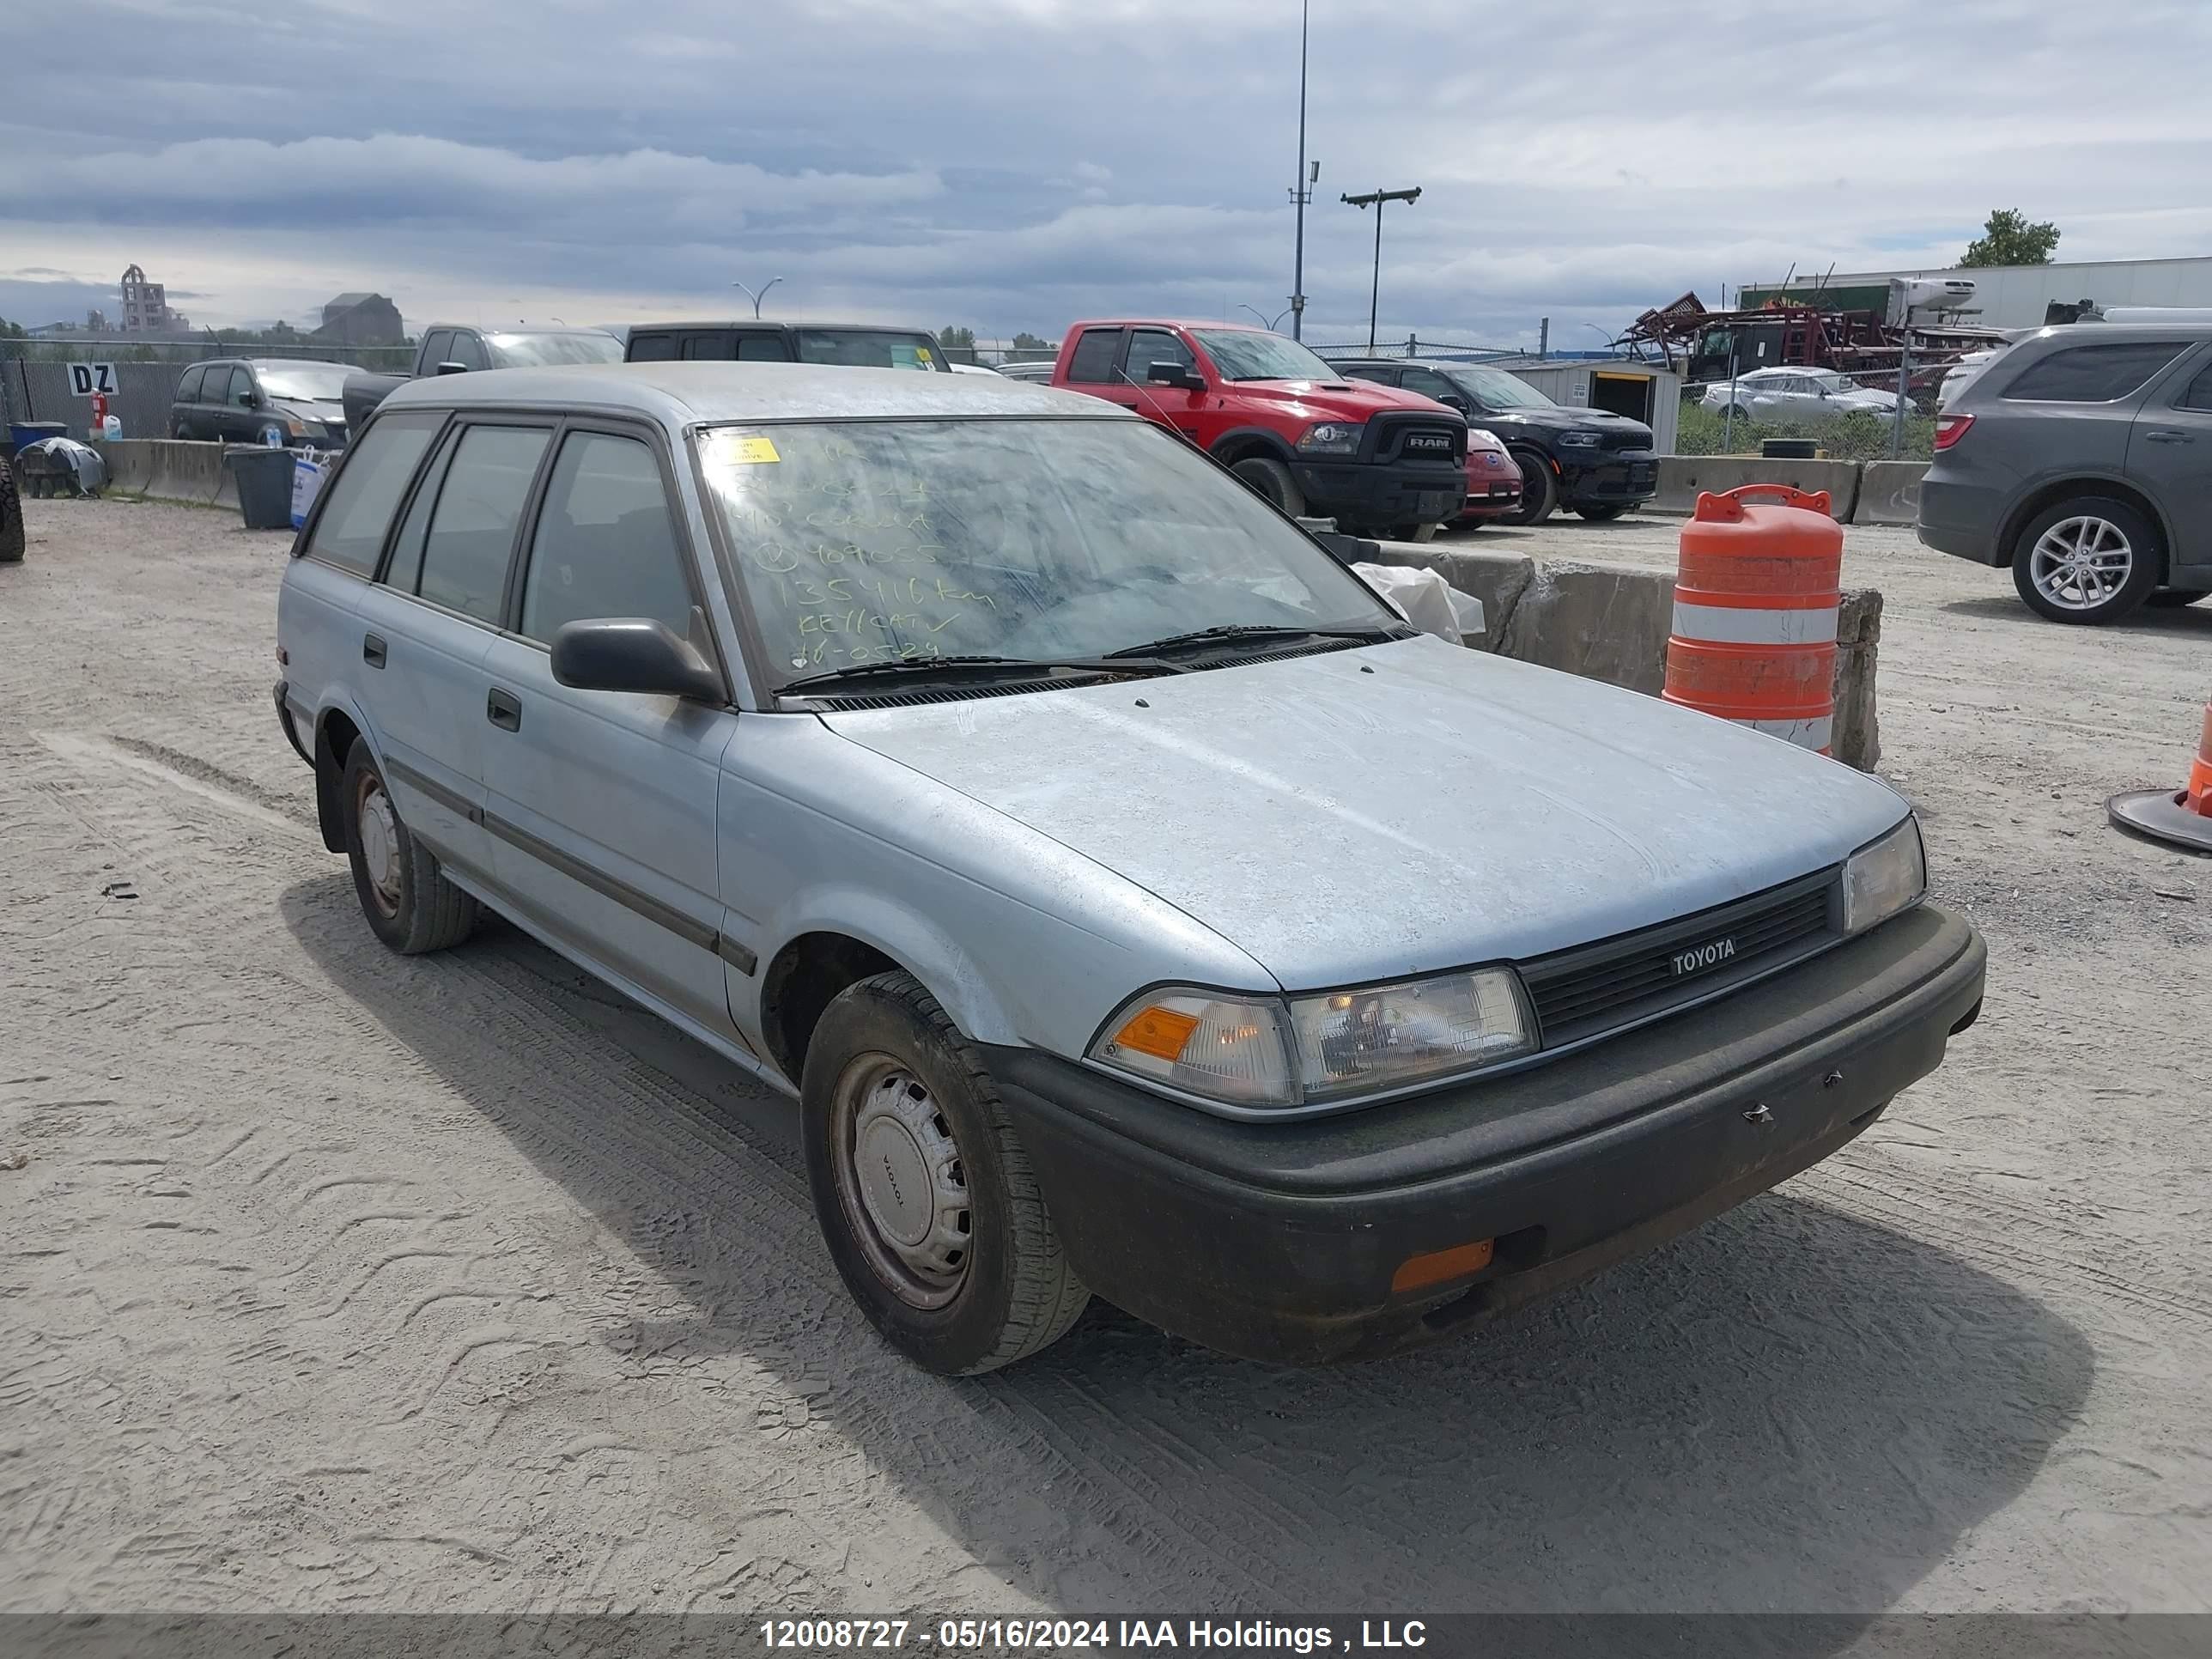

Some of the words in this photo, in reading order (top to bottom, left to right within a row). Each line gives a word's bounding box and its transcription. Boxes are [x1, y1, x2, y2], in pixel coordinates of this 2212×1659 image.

[73, 365, 113, 393] DZ
[1410, 438, 1449, 447] RAM
[804, 541, 946, 568] 409055
[1674, 939, 1735, 975] TOYOTA
[883, 1154, 904, 1208] TOYOTA
